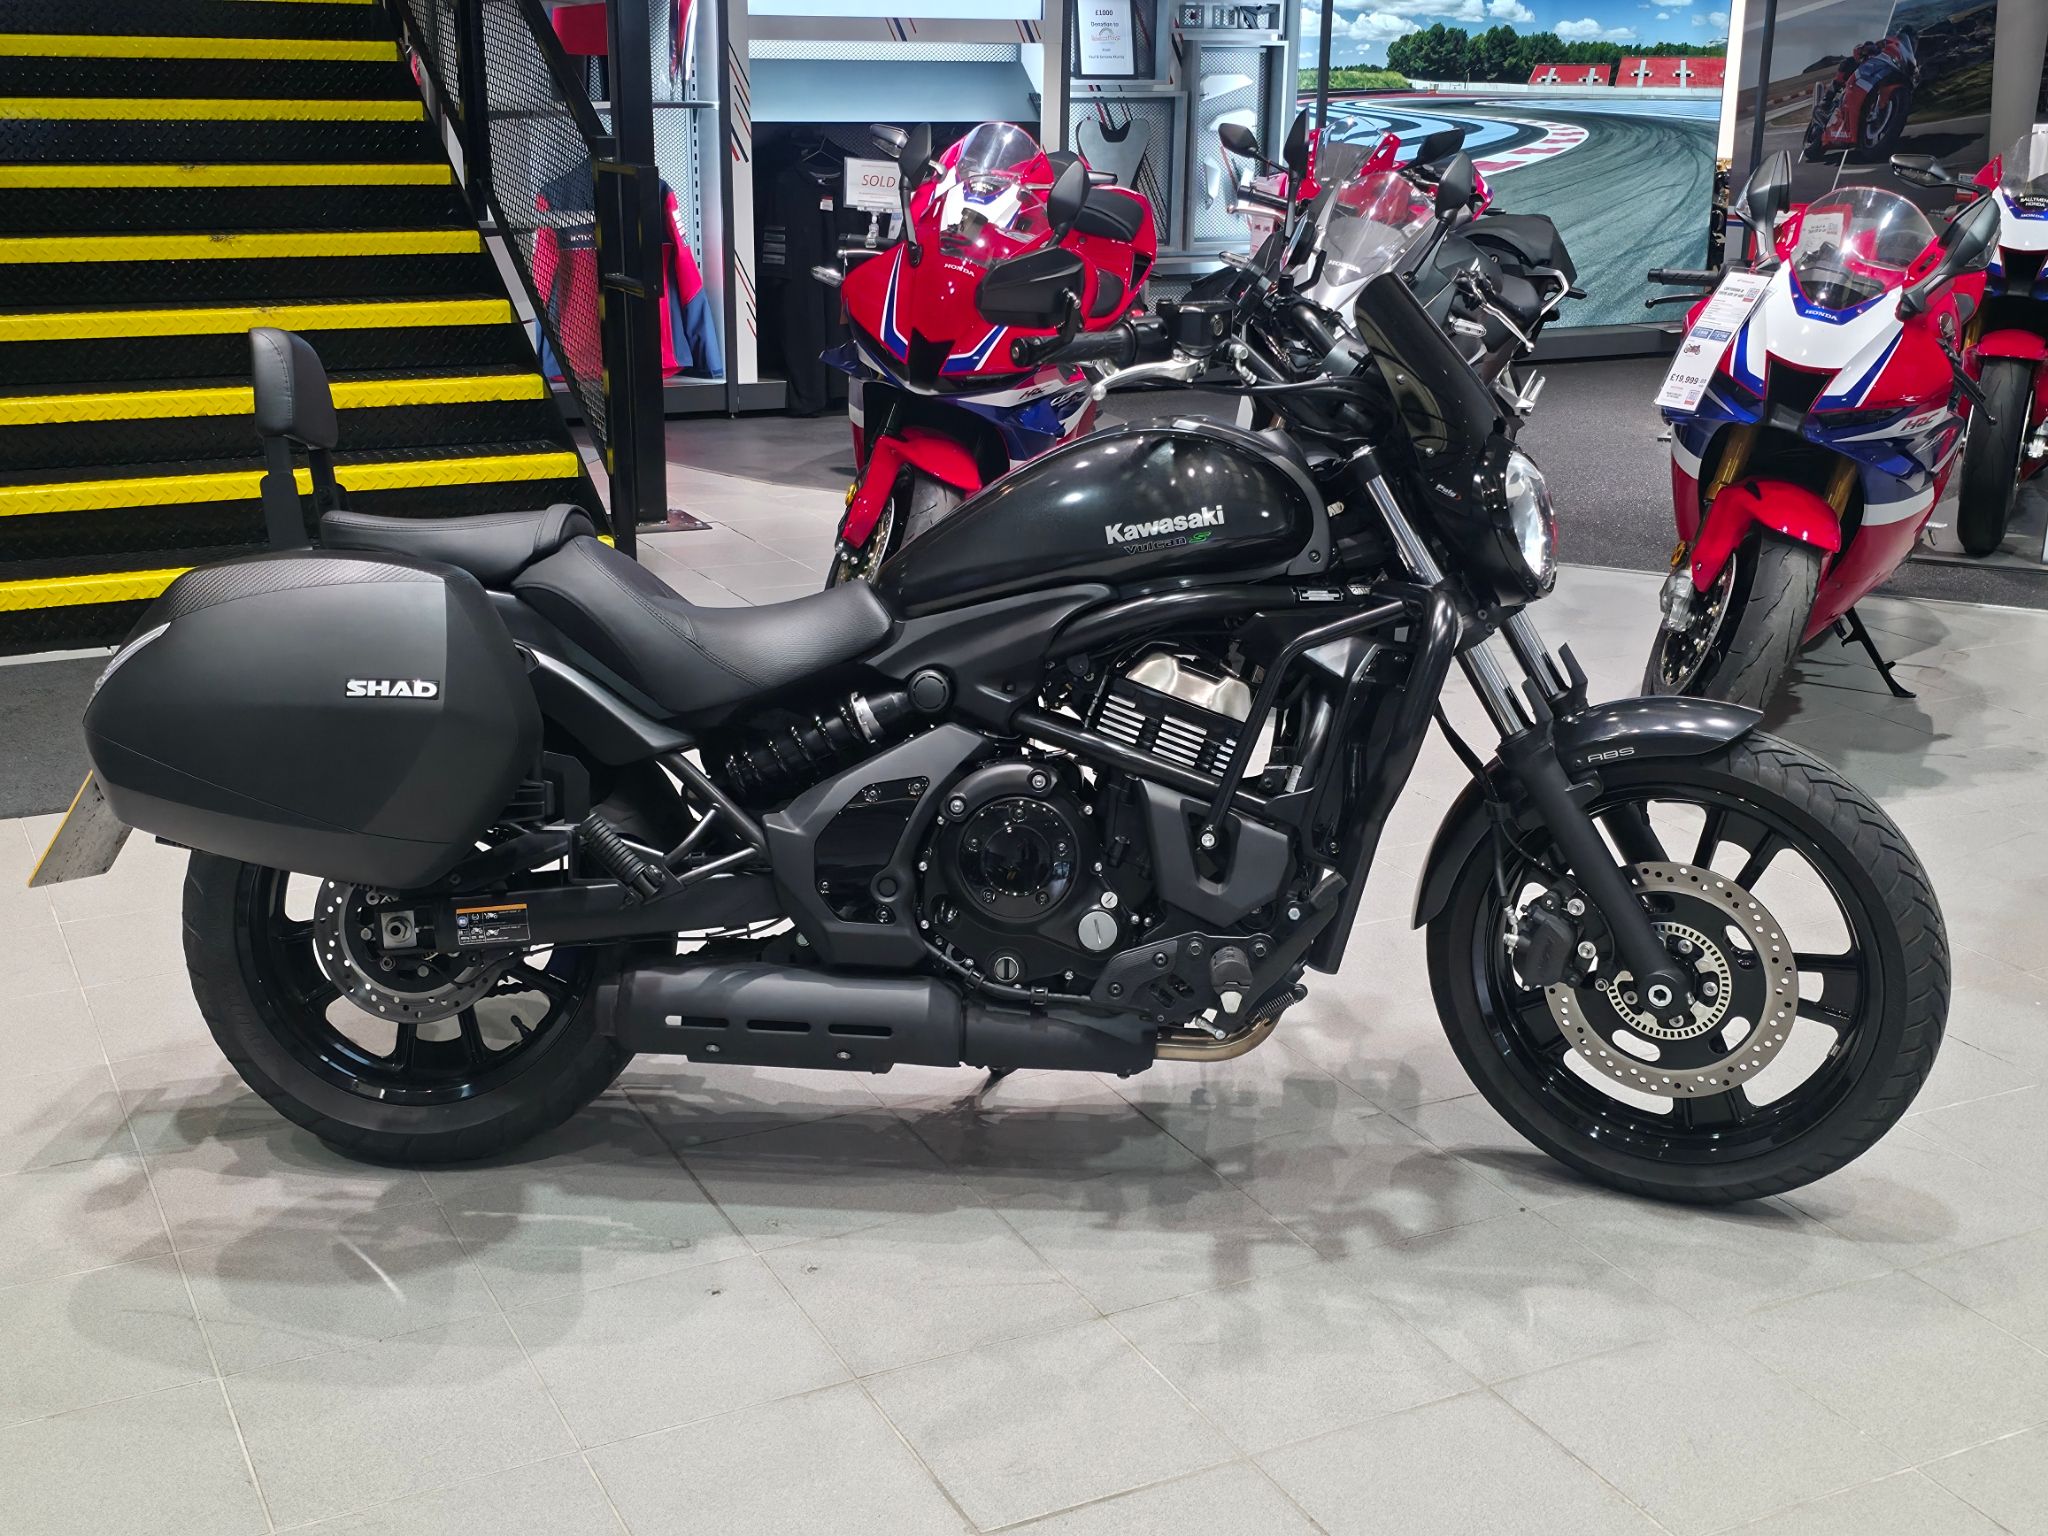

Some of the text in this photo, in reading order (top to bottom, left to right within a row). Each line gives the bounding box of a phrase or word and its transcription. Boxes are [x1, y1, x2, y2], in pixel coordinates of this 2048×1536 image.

[861, 174, 896, 188] SOLD
[943, 262, 976, 278] HONDA
[1804, 309, 1839, 321] HONDA
[1669, 372, 1699, 386] £19,999
[1899, 411, 1941, 432] HRC
[1104, 504, 1225, 545] Kawasaki
[1188, 531, 1212, 544] S
[345, 679, 438, 698] SHAD
[1587, 746, 1635, 763] ABS
